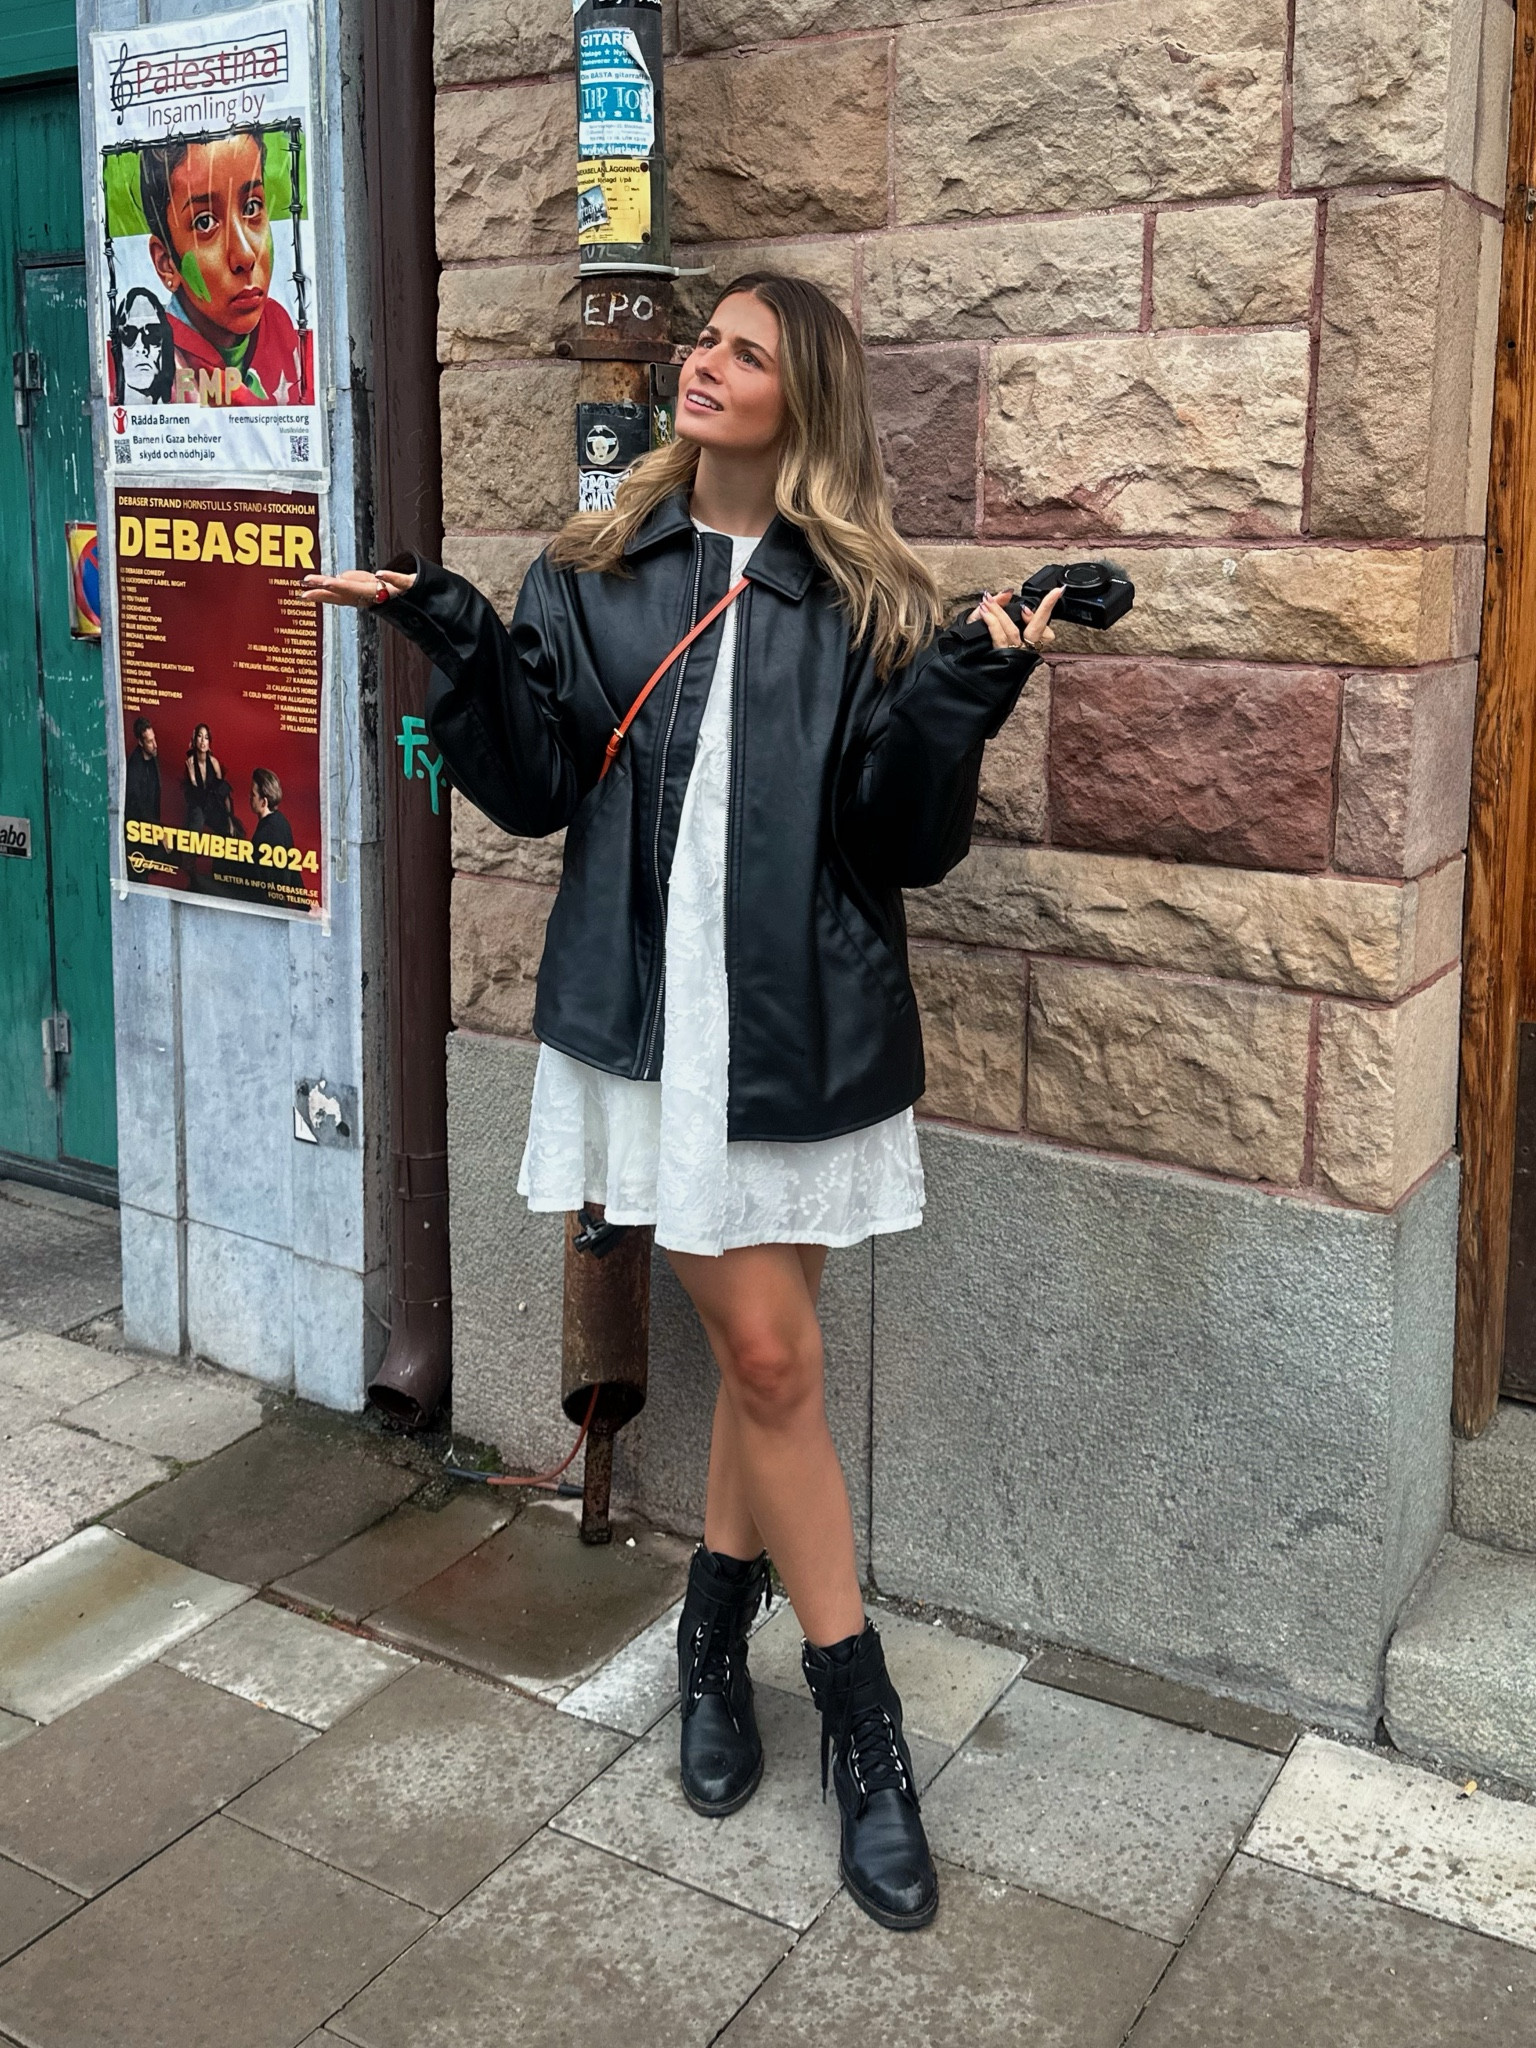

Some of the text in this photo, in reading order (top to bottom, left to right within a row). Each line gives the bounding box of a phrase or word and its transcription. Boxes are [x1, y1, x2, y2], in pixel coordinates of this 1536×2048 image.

[136, 45, 278, 98] Palestina
[582, 86, 644, 110] TIP TO
[148, 91, 265, 127] Insamling by
[584, 293, 653, 326] EPO
[175, 367, 242, 406] FMP
[131, 414, 190, 425] Rädda Barnen
[229, 414, 310, 426] freemusicprojects.org
[133, 434, 159, 444] Barnen
[166, 435, 185, 444] Gaza
[187, 434, 221, 444] behöver
[139, 449, 215, 461] skydd och nödhjälp
[118, 496, 315, 515] DEBASER STRAND HORNSTULLS STRAND 4 STOCKHOLM
[119, 516, 315, 569] DEBASER
[287, 609, 316, 617] DISCHARGE
[291, 638, 316, 646] TELENOVA
[293, 648, 316, 656] PRODUCT
[272, 655, 295, 664] PARADOX
[296, 658, 317, 666] OBSCUR
[178, 664, 194, 672] TIGERS
[249, 691, 261, 699] COLD
[277, 694, 287, 702] FOR
[288, 695, 317, 705] ALLIGATORS
[287, 714, 298, 722] REAL
[299, 716, 317, 724] ESTATE
[126, 820, 319, 873] SEPTEMBER 2024
[214, 873, 319, 898] BILJETTER & INFO PÅ DEBASER.SE
[268, 891, 319, 907] FOTO: TELENOVA
